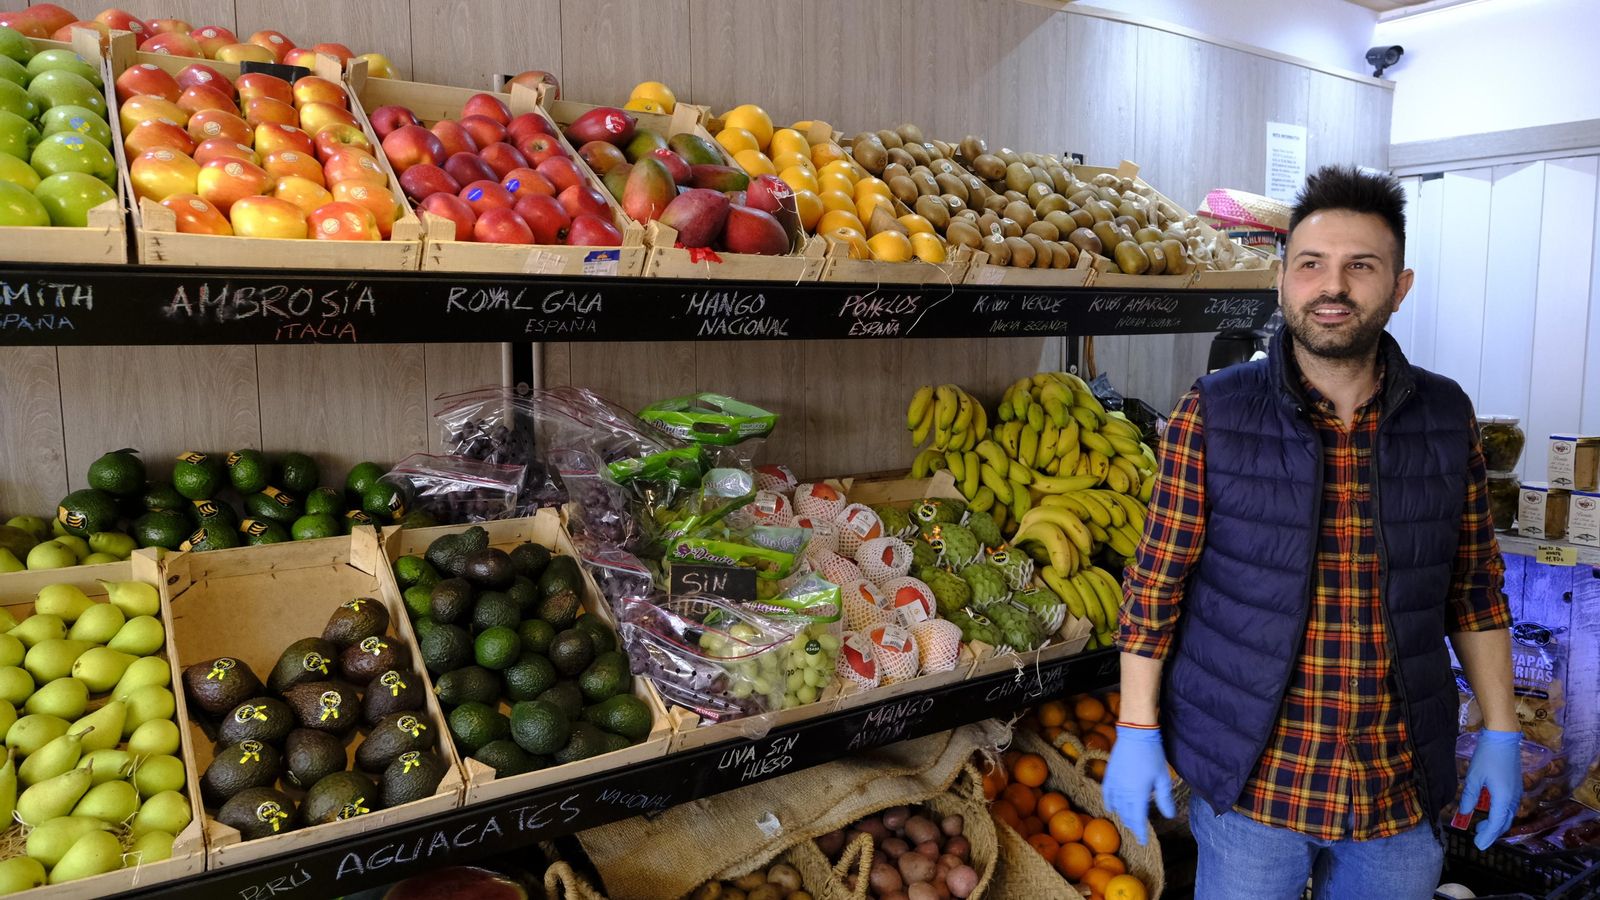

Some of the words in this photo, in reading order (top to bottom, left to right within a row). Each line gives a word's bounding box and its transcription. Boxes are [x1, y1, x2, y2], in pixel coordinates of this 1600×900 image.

[446, 286, 534, 313] ROYAL
[541, 289, 603, 314] GALA
[685, 291, 766, 317] MANGO
[1021, 294, 1068, 313] VERDE
[0, 314, 76, 332] PAÑA
[524, 316, 597, 334] ESPAÑA
[848, 319, 901, 336] ESPAÑA
[1512, 665, 1554, 683] RITAS
[862, 697, 935, 730] MANGO
[717, 745, 756, 769] UVA
[741, 755, 793, 782] HUESO
[335, 793, 581, 881] AGUACATES
